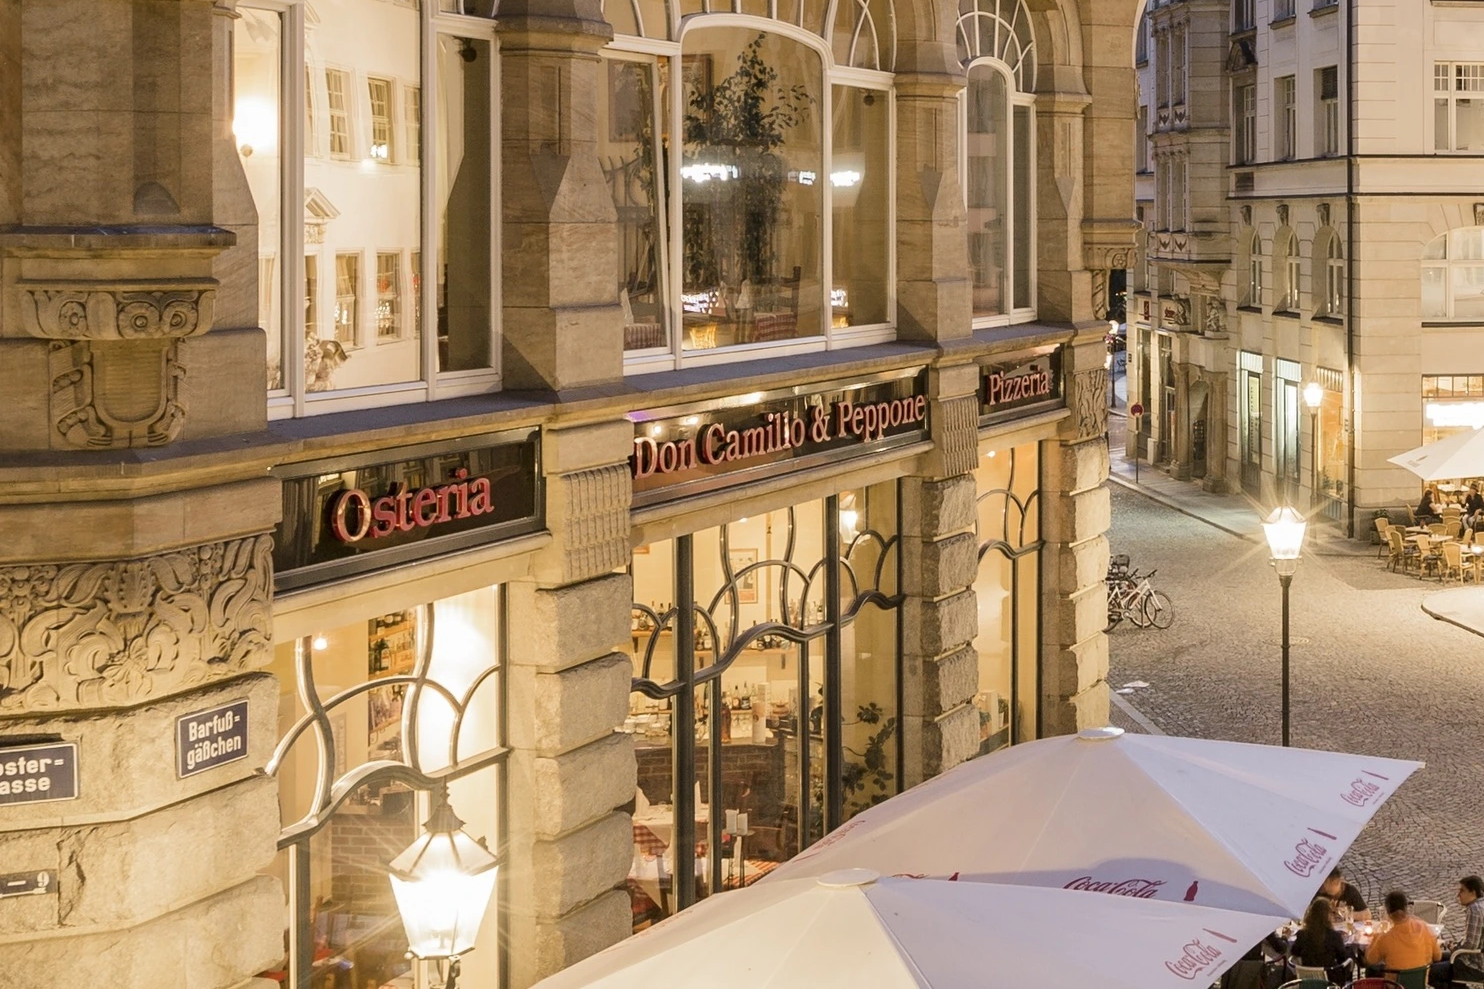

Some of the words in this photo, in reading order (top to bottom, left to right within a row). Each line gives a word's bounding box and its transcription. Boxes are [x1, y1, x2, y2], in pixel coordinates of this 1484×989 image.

[988, 364, 1051, 406] Pizzeria
[633, 436, 697, 480] Don
[702, 411, 806, 466] Camillo
[811, 409, 831, 443] &
[837, 394, 926, 442] Peppone
[332, 467, 495, 543] Osteria
[187, 735, 242, 770] gäßchen
[37, 871, 50, 887] 9
